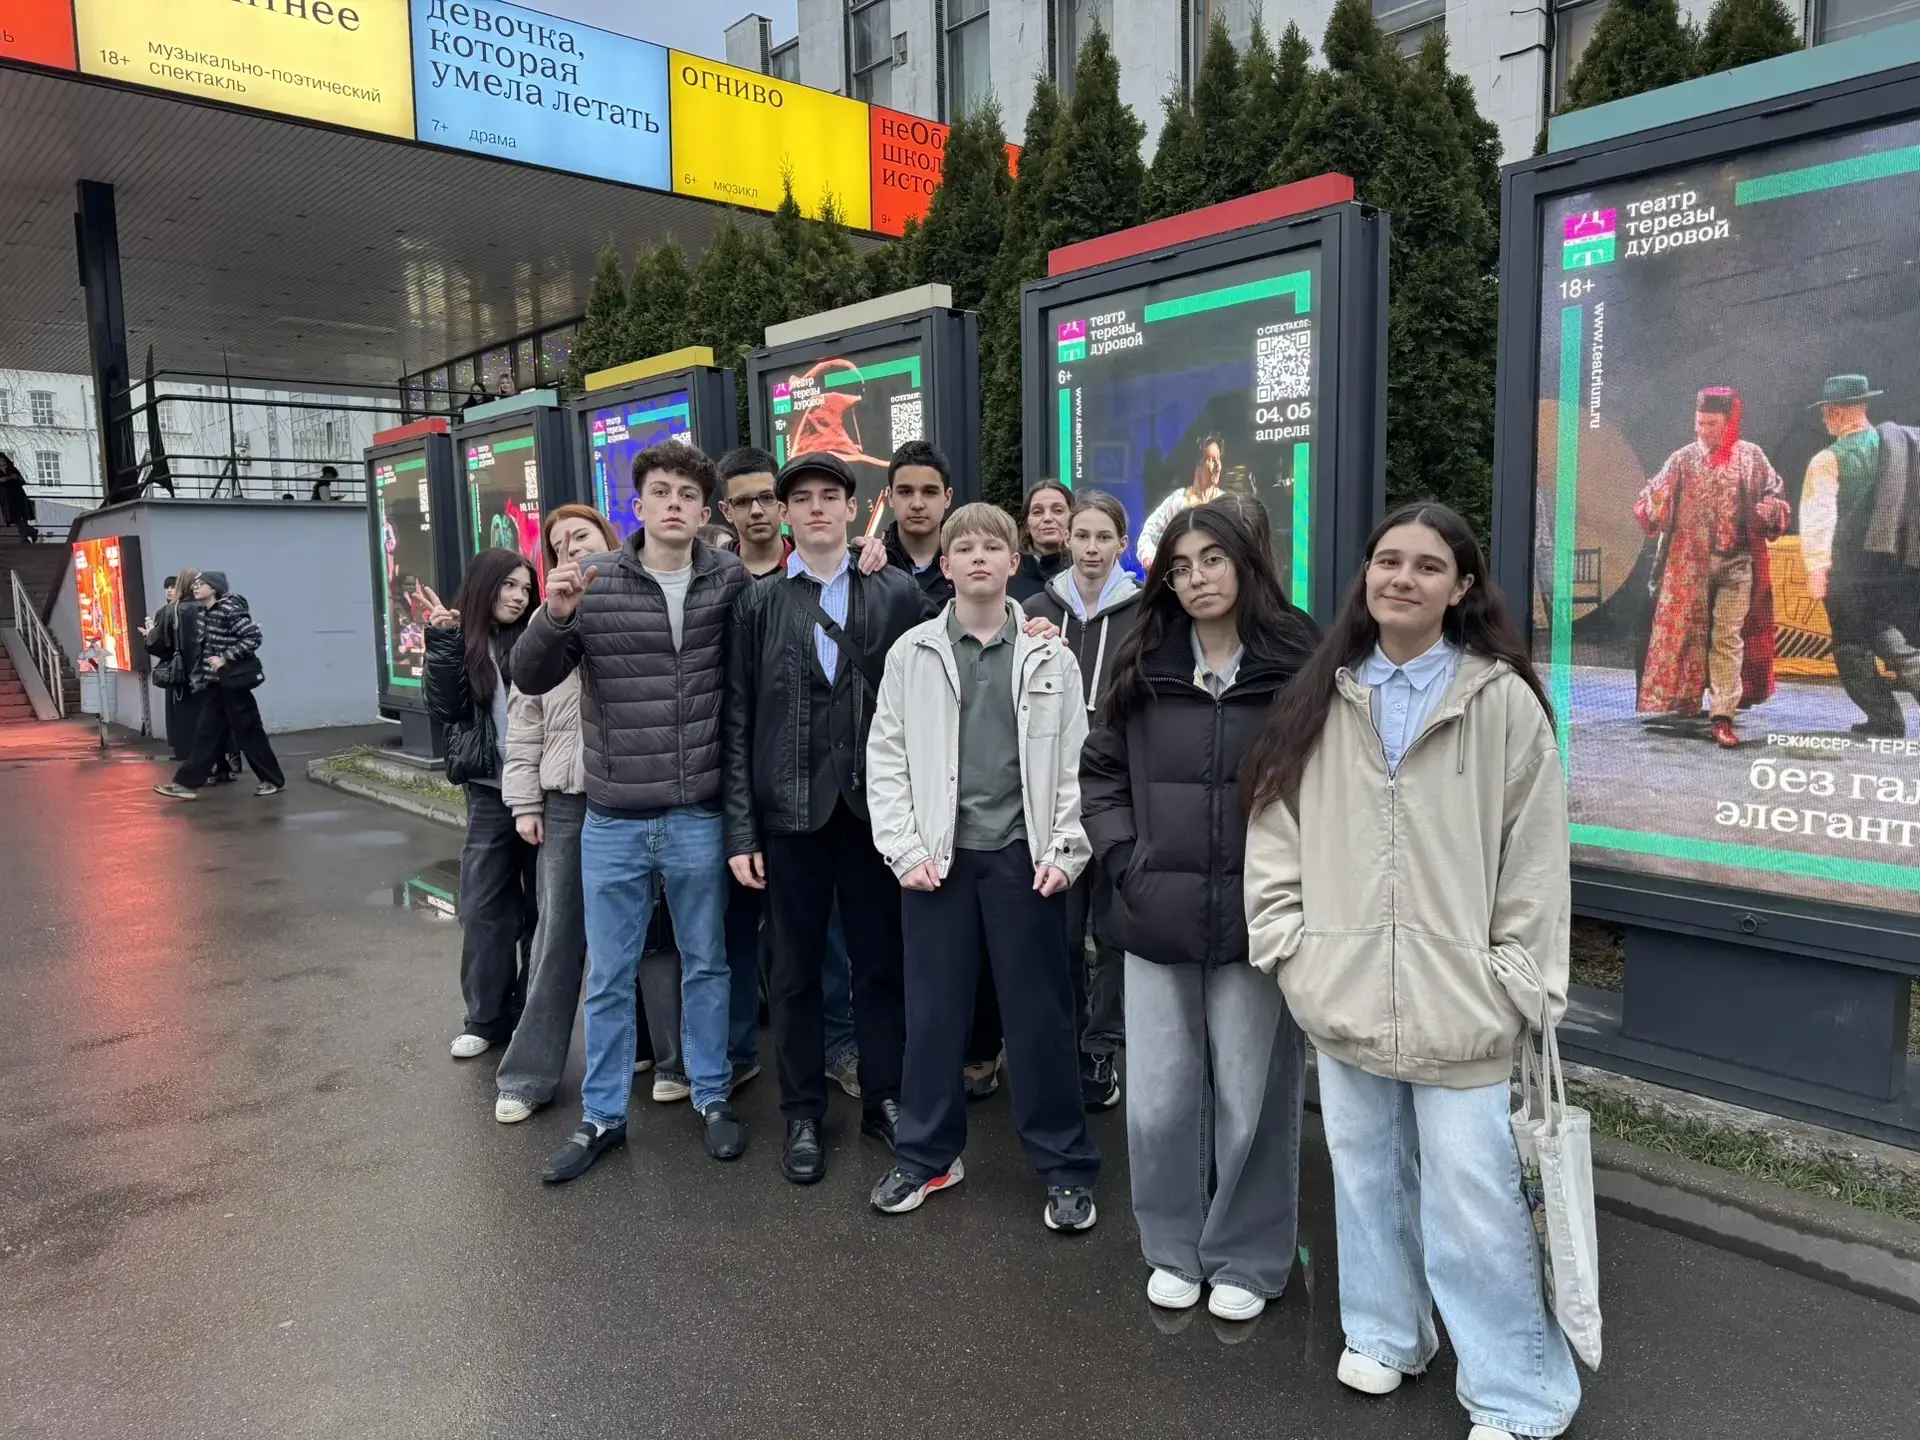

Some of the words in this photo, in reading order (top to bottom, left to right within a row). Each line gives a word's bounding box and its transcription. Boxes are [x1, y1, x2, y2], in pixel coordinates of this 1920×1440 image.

[426, 0, 585, 61] девочка,
[99, 49, 131, 67] 18+
[428, 28, 580, 86] которая
[147, 41, 382, 104] музыкально-поэтический
[148, 60, 247, 94] спектакль
[428, 59, 546, 109] умела
[552, 90, 660, 135] летать
[682, 66, 784, 109] огниво
[431, 119, 449, 133] 7+
[468, 127, 517, 149] драма
[880, 117, 948, 150] неОб
[684, 173, 698, 185] 6+
[713, 180, 759, 199] мюзикл
[1626, 189, 1697, 217] театр
[880, 213, 892, 224] 9+
[1625, 206, 1715, 237] терезы
[1624, 218, 1730, 259] дуровой
[1559, 277, 1596, 299] 18+
[1089, 310, 1127, 328] театр
[1089, 322, 1137, 342] терезы
[1089, 331, 1144, 357] дуровой
[1058, 369, 1073, 385] 6+
[1589, 301, 1605, 430] www.teatrium.ru
[1256, 406, 1284, 425] 04,
[1287, 402, 1312, 420] 05
[1256, 424, 1312, 442] апреля
[1867, 738, 1920, 757] ТЕРЕ
[1749, 757, 1836, 797] без
[1715, 800, 1920, 847] элегант
